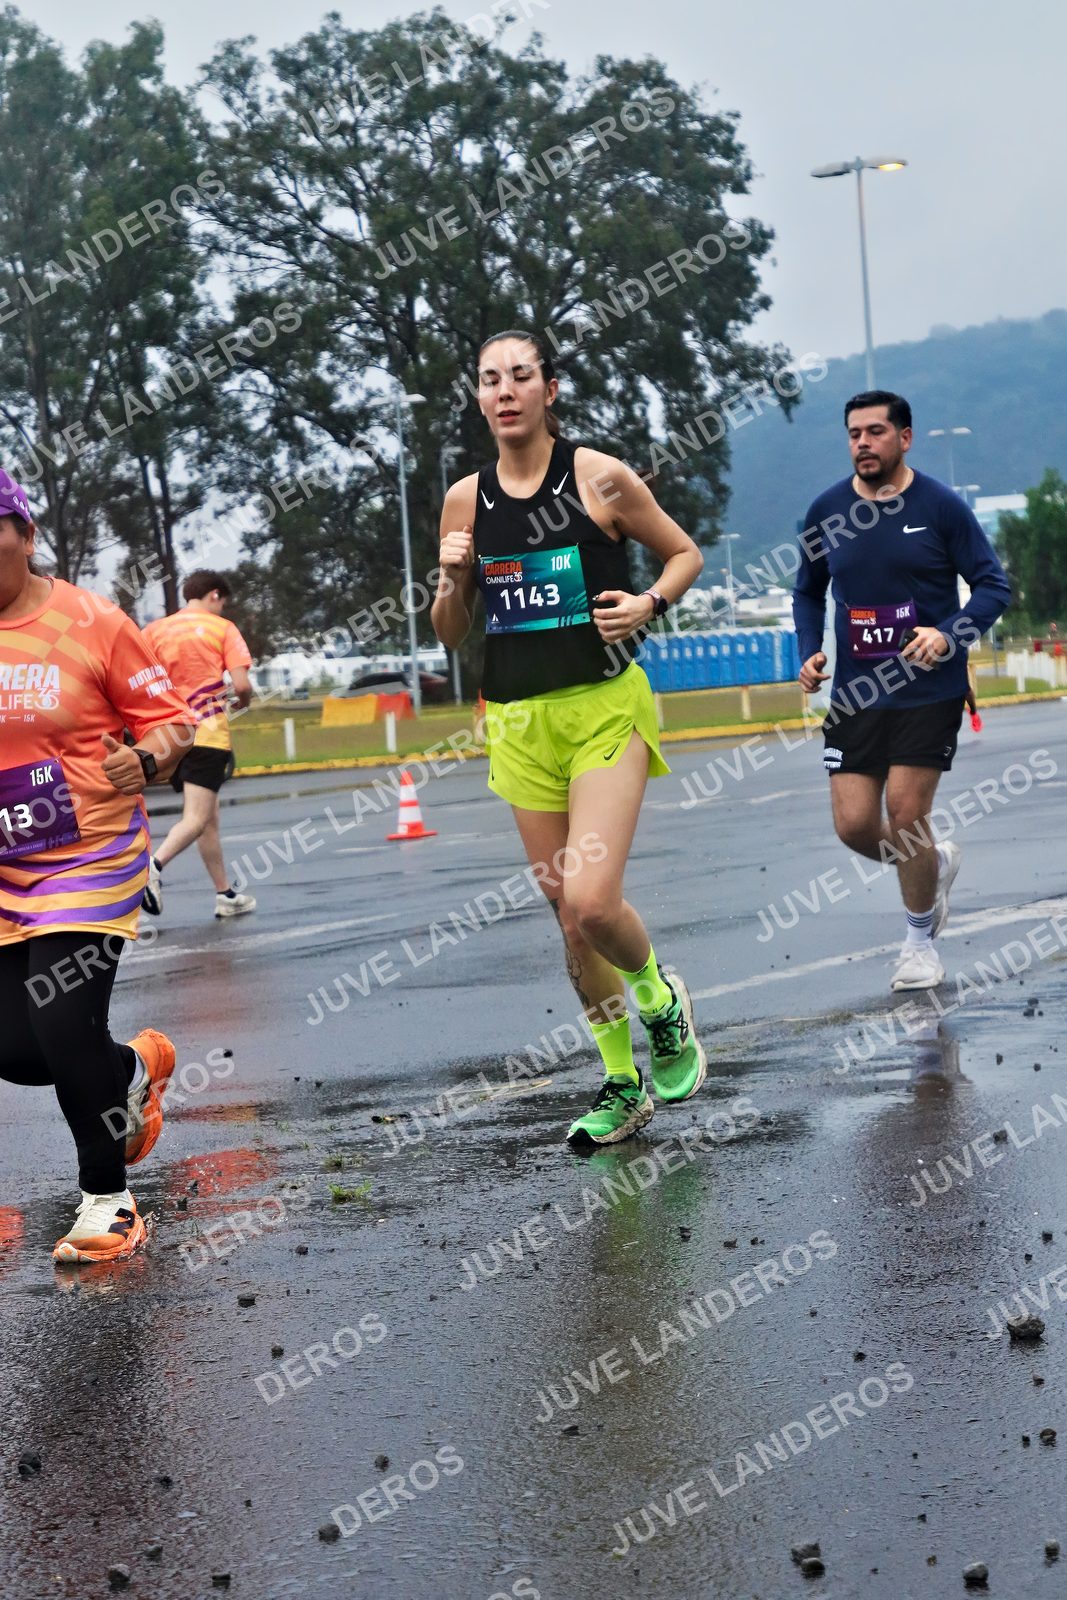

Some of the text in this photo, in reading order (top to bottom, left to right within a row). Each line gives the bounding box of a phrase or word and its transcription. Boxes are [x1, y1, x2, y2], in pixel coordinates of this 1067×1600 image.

[485, 561, 523, 576] CARRERA
[551, 554, 571, 571] 10K
[500, 583, 560, 610] 1143
[896, 606, 910, 618] 15K
[863, 627, 894, 643] 417
[30, 765, 54, 787] 15K
